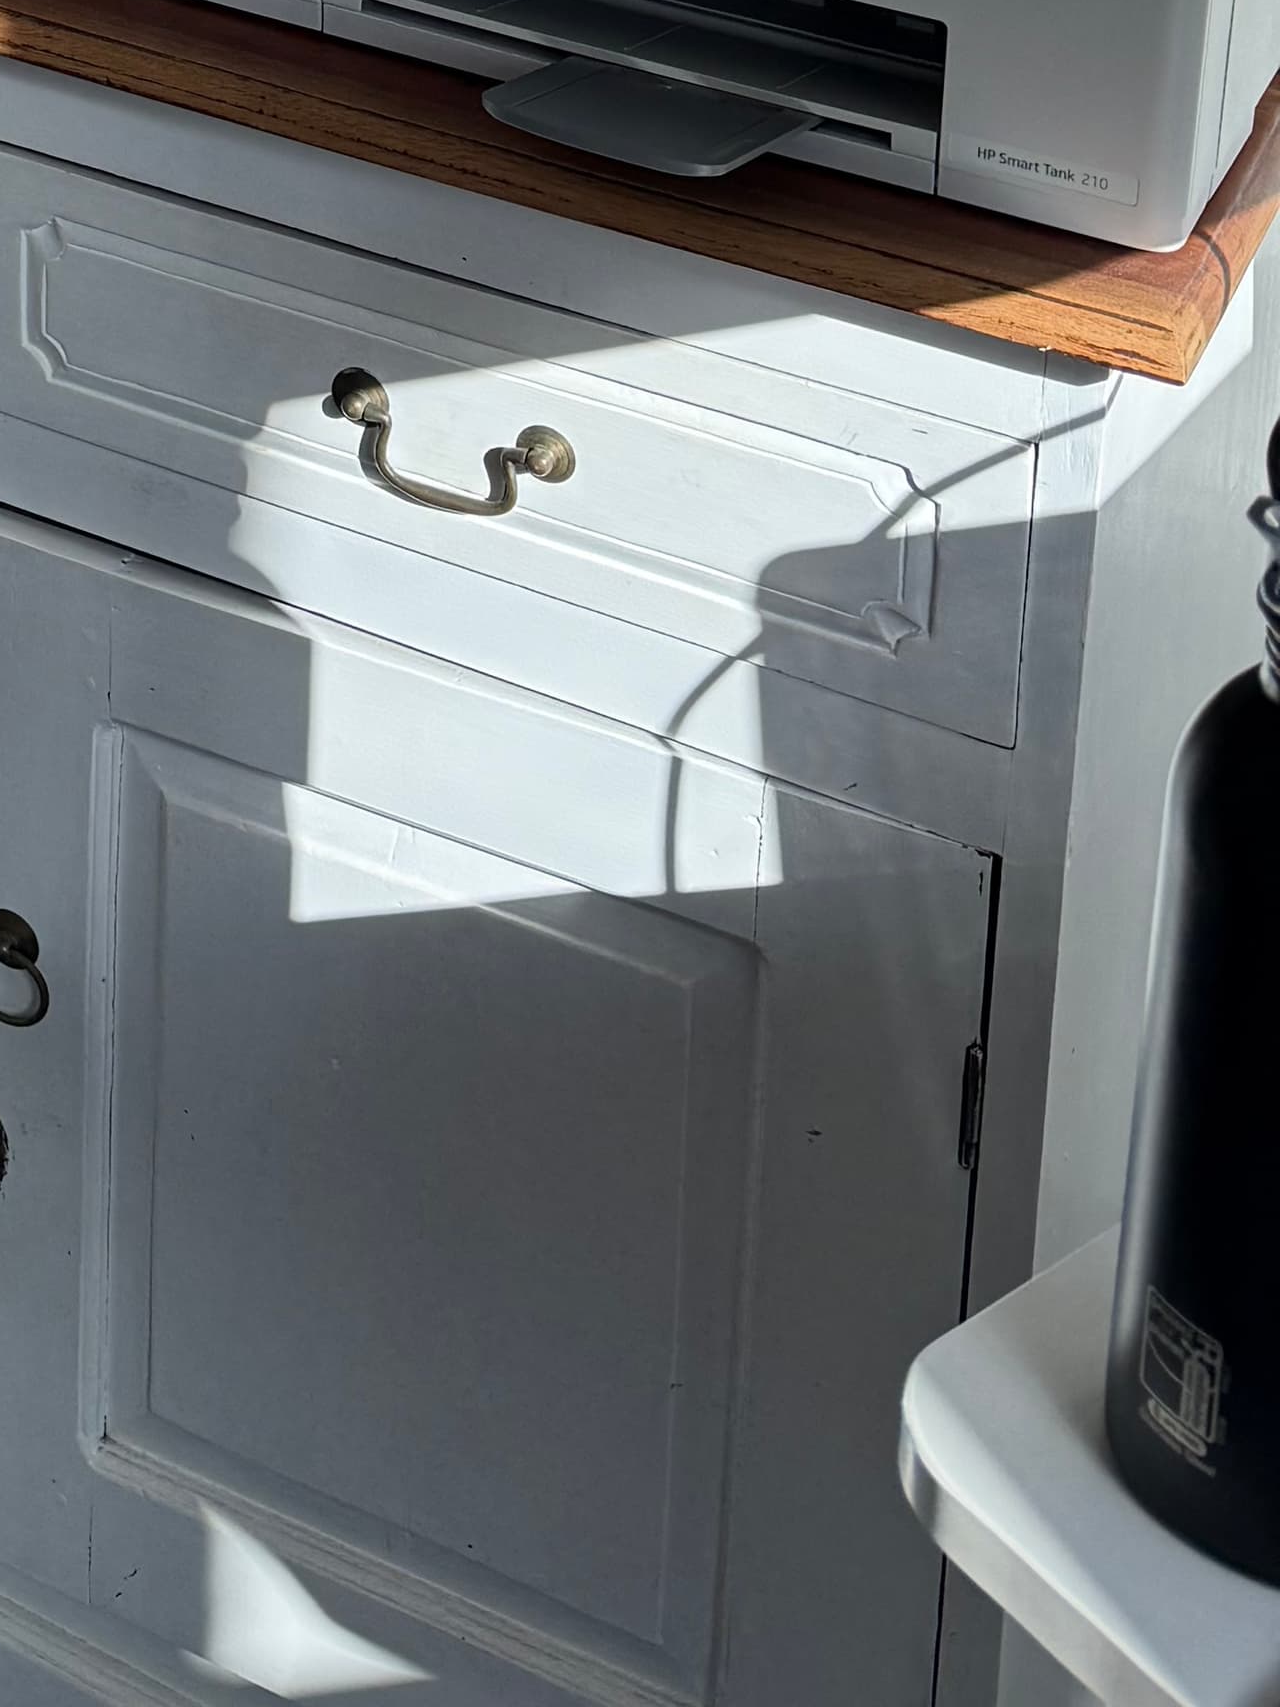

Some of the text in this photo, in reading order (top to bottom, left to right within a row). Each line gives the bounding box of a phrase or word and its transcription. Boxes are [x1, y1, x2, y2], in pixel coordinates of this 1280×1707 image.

[977, 145, 1110, 192] HP Smart Tank 210
